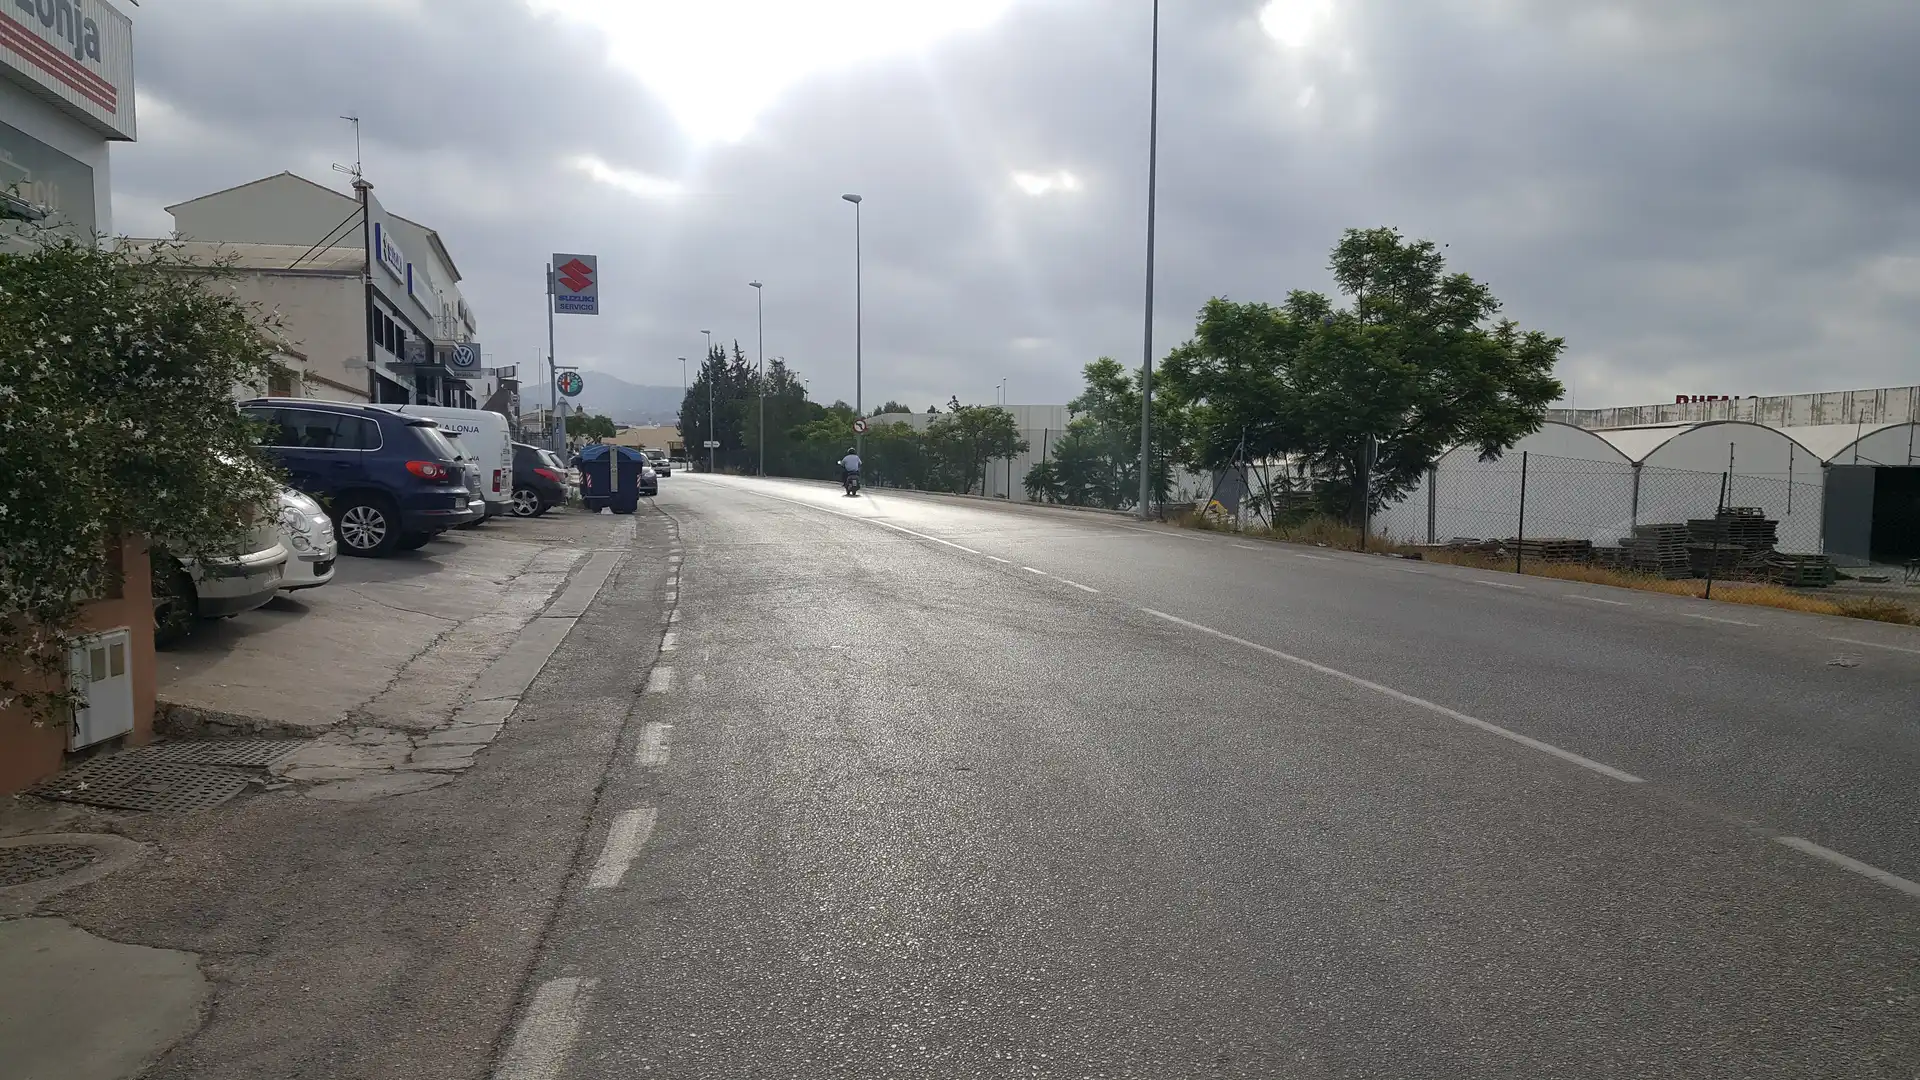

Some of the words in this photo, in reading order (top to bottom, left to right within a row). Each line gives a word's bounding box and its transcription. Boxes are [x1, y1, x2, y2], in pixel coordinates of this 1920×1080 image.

[558, 295, 595, 303] SUZUKI
[559, 303, 594, 311] SERVICIO
[452, 425, 480, 433] LONJA
